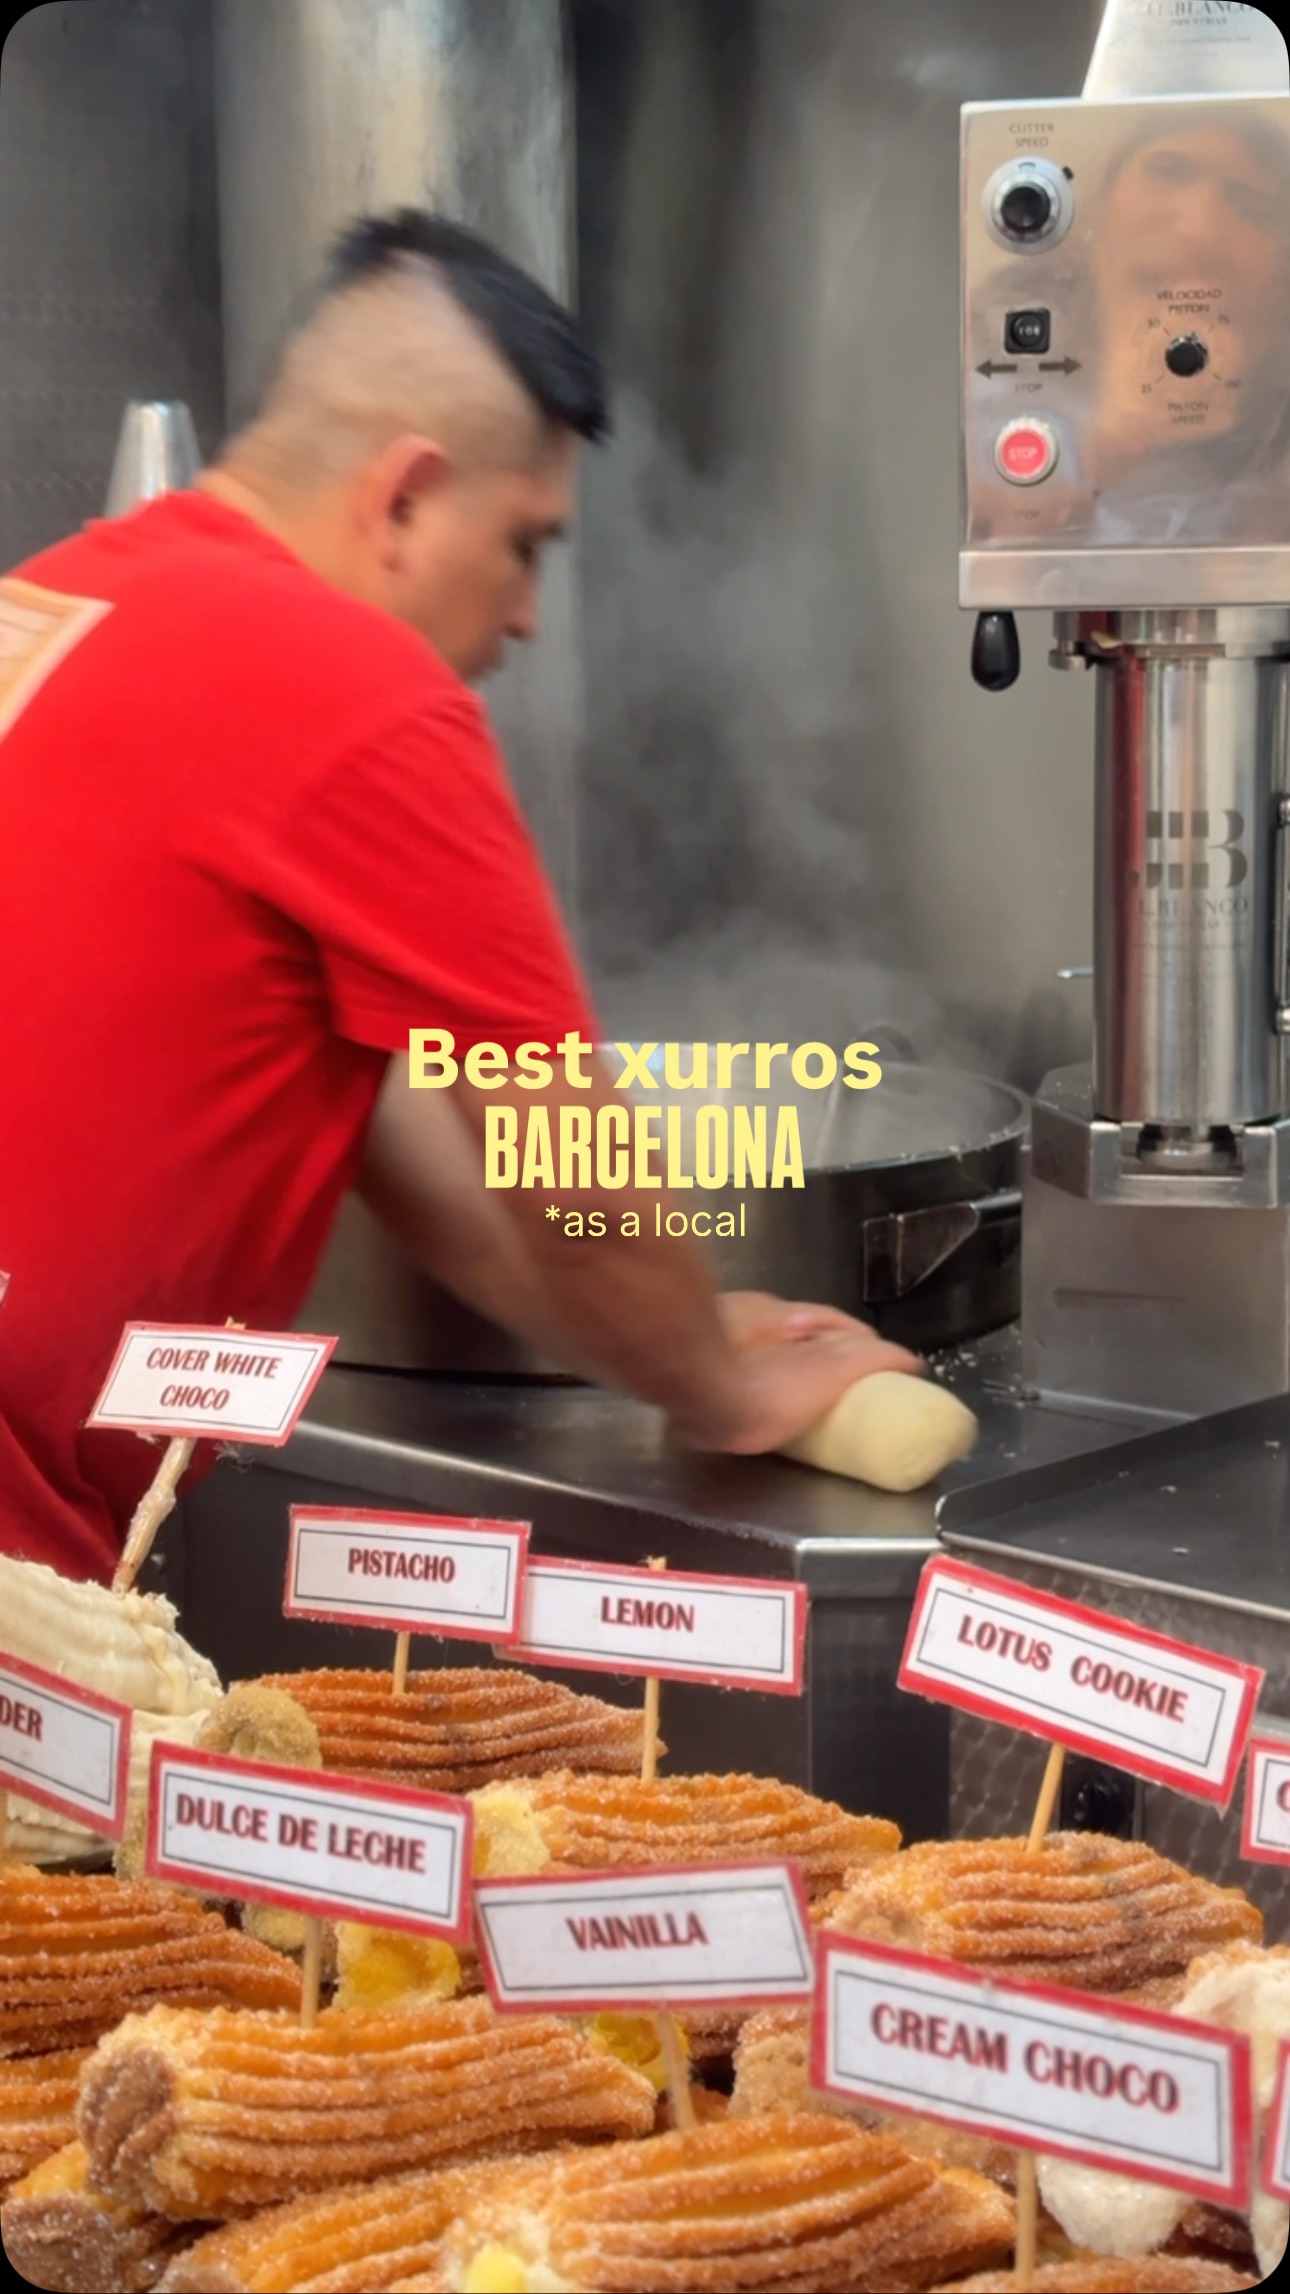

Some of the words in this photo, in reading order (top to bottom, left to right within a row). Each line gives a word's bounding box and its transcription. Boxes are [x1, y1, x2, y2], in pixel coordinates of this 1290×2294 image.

[1009, 122, 1055, 134] CUTTER
[1015, 137, 1050, 148] SPEED
[1156, 288, 1222, 301] VELOCIDAD
[1168, 304, 1210, 314] PISTON
[1015, 383, 1043, 393] STOP
[1008, 447, 1038, 460] STOP
[146, 1347, 210, 1372] COVER
[214, 1351, 282, 1379] WHITE
[160, 1384, 230, 1411] CHOCO
[348, 1547, 456, 1583] PISTACHO
[601, 1596, 694, 1632] LEMON
[957, 1614, 1052, 1672] LOTUS
[1070, 1655, 1188, 1723] COOKIE
[0, 1694, 42, 1742] DER
[176, 1793, 268, 1842] DULCE
[278, 1813, 318, 1852] DE
[327, 1823, 426, 1875] LECHE
[566, 1911, 709, 1951] VAINILLA
[871, 2003, 1006, 2073] CREAM
[1024, 2041, 1178, 2114] CHOCO
